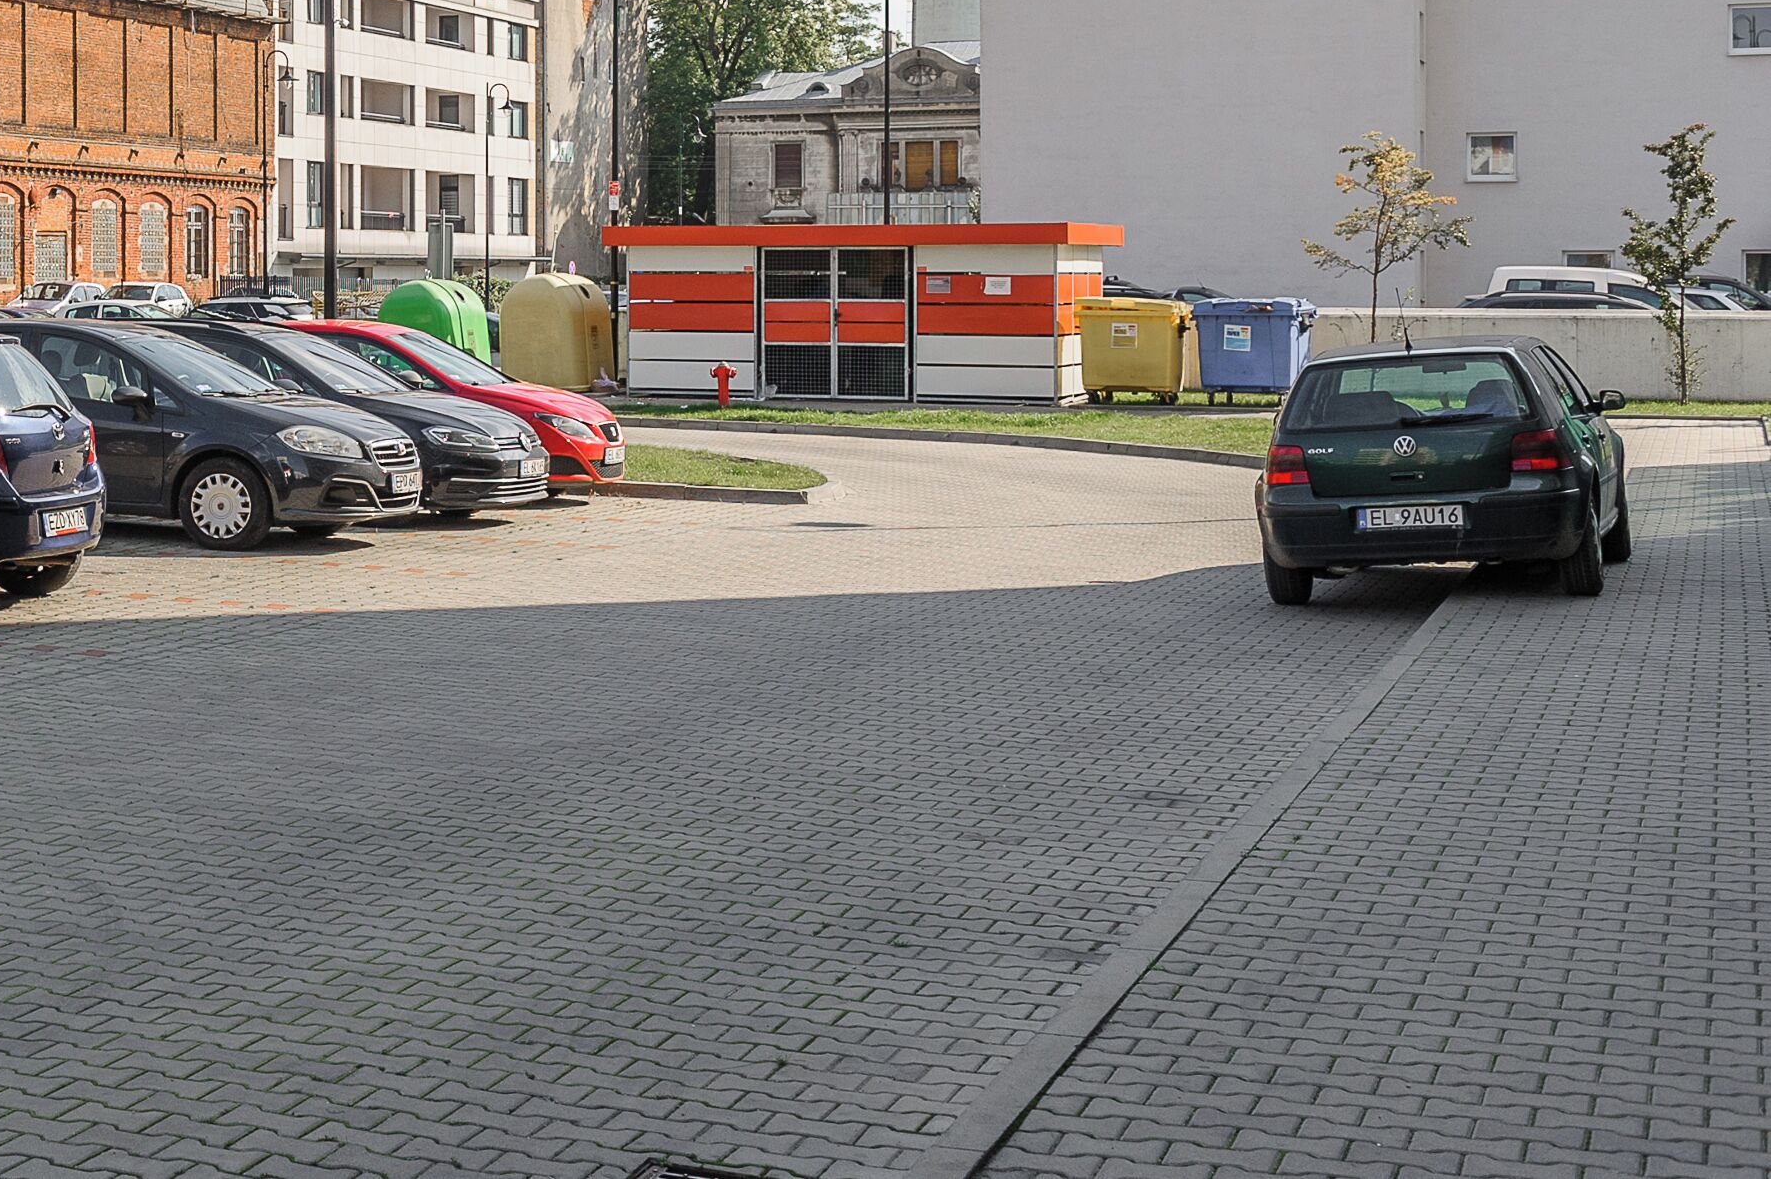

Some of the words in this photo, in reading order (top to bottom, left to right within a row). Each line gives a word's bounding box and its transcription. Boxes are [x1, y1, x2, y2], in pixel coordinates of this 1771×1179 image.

[48, 512, 66, 531] EZD
[1370, 509, 1394, 526] EL
[1400, 507, 1459, 525] 9AU16
